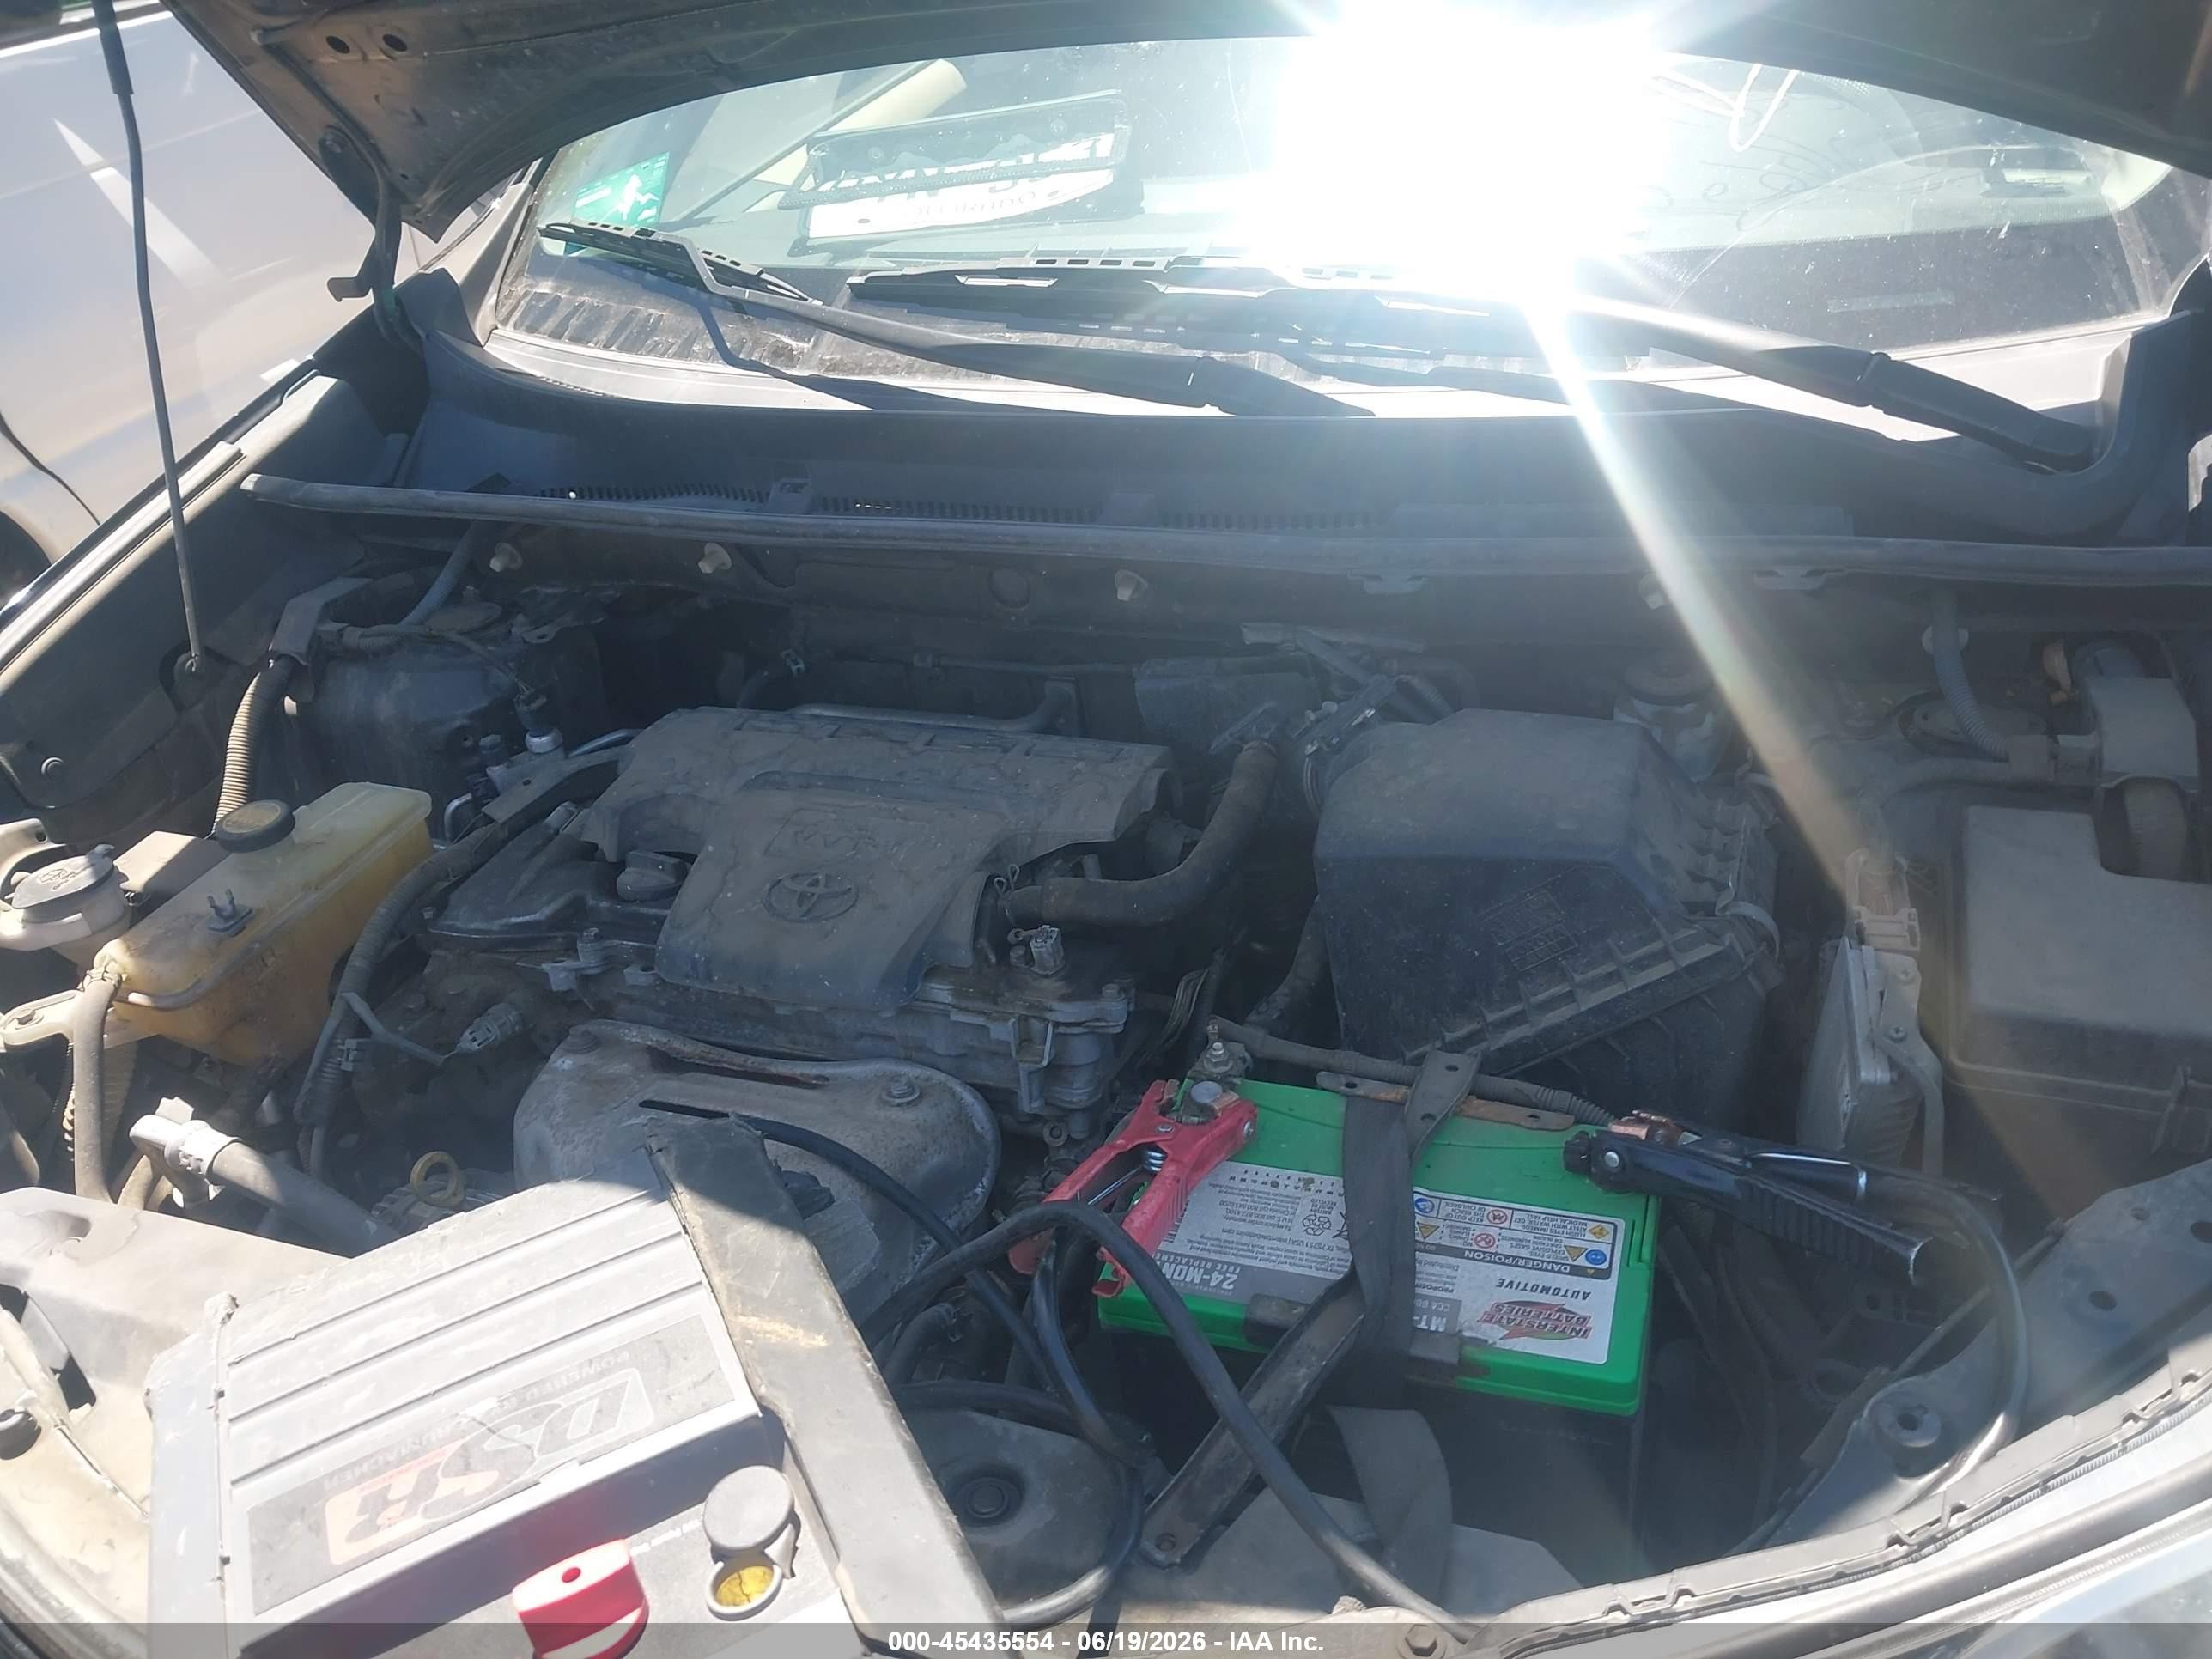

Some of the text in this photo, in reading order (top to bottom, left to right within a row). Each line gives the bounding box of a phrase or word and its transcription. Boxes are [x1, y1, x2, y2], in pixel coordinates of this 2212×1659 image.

[1214, 1262, 1240, 1273] FREE
[1463, 1249, 1570, 1273] DANGER/POISON
[1494, 1277, 1591, 1301] AUTOMOTIVE
[1479, 1310, 1590, 1339] INTERSTATE
[1489, 1302, 1589, 1326] BATTERIES
